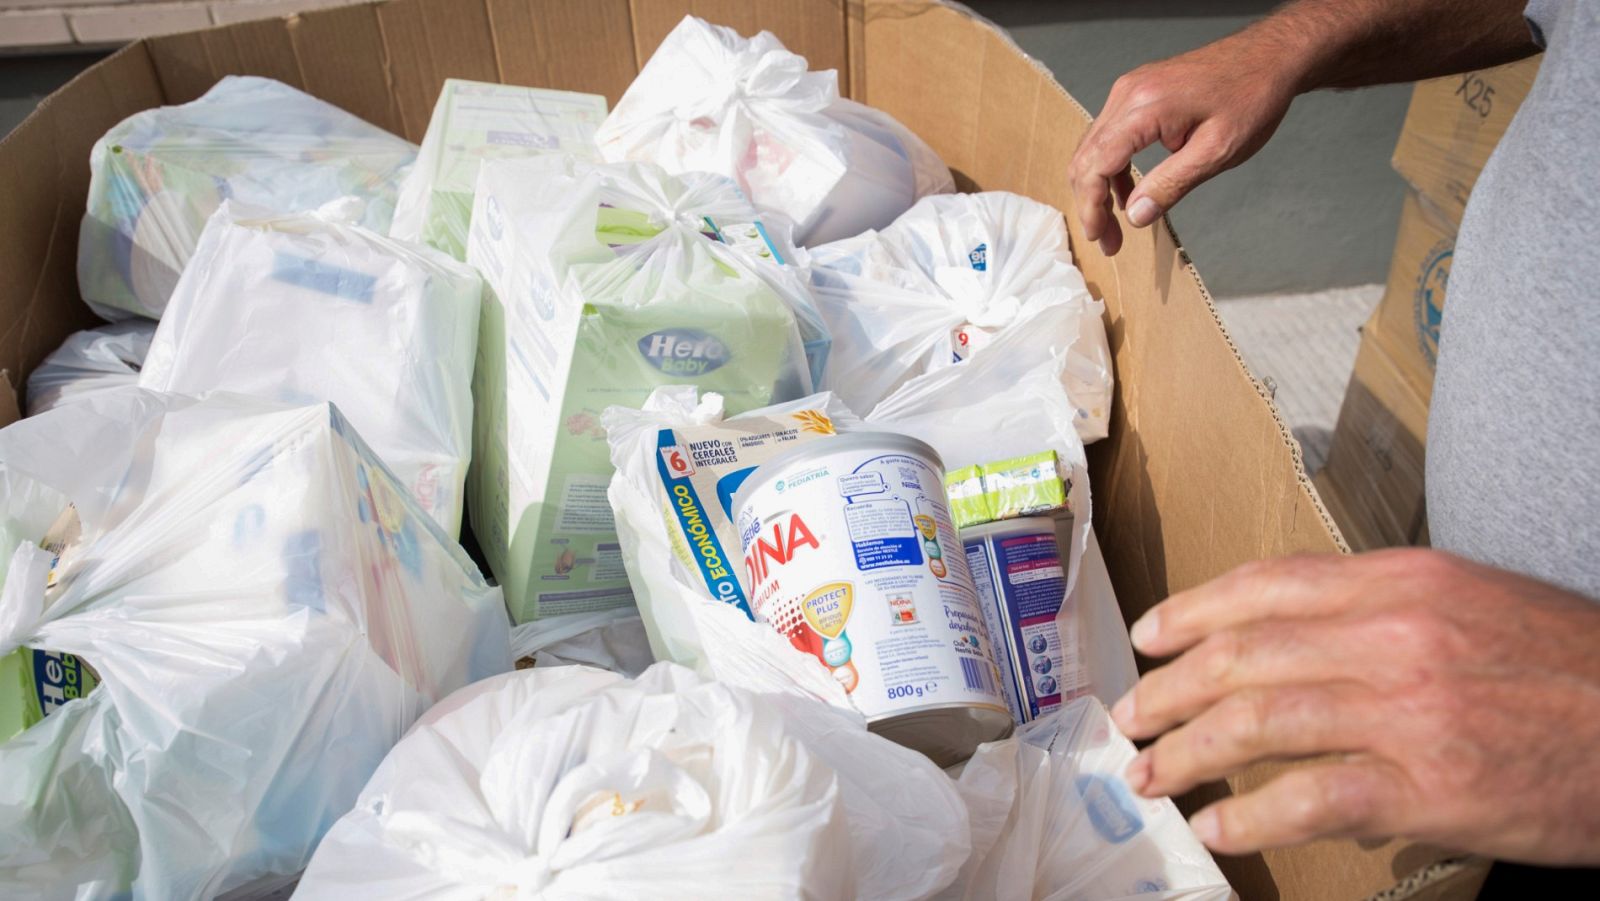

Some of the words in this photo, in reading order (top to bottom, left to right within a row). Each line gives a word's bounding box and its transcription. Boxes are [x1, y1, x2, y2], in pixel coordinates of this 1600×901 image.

[1455, 72, 1496, 118] X25
[648, 335, 724, 359] Hero
[661, 358, 709, 374] Baby
[689, 439, 720, 452] NUEVO
[692, 447, 735, 460] CEREALES
[670, 451, 687, 472] 6
[694, 455, 738, 468] INTEGRALES
[673, 484, 728, 580] ECONÓMICO
[745, 513, 820, 598] DINA
[806, 588, 847, 609] PROTECT
[816, 601, 839, 615] PLUS
[62, 653, 79, 699] Bab
[887, 684, 914, 699] 800
[915, 687, 923, 697] g
